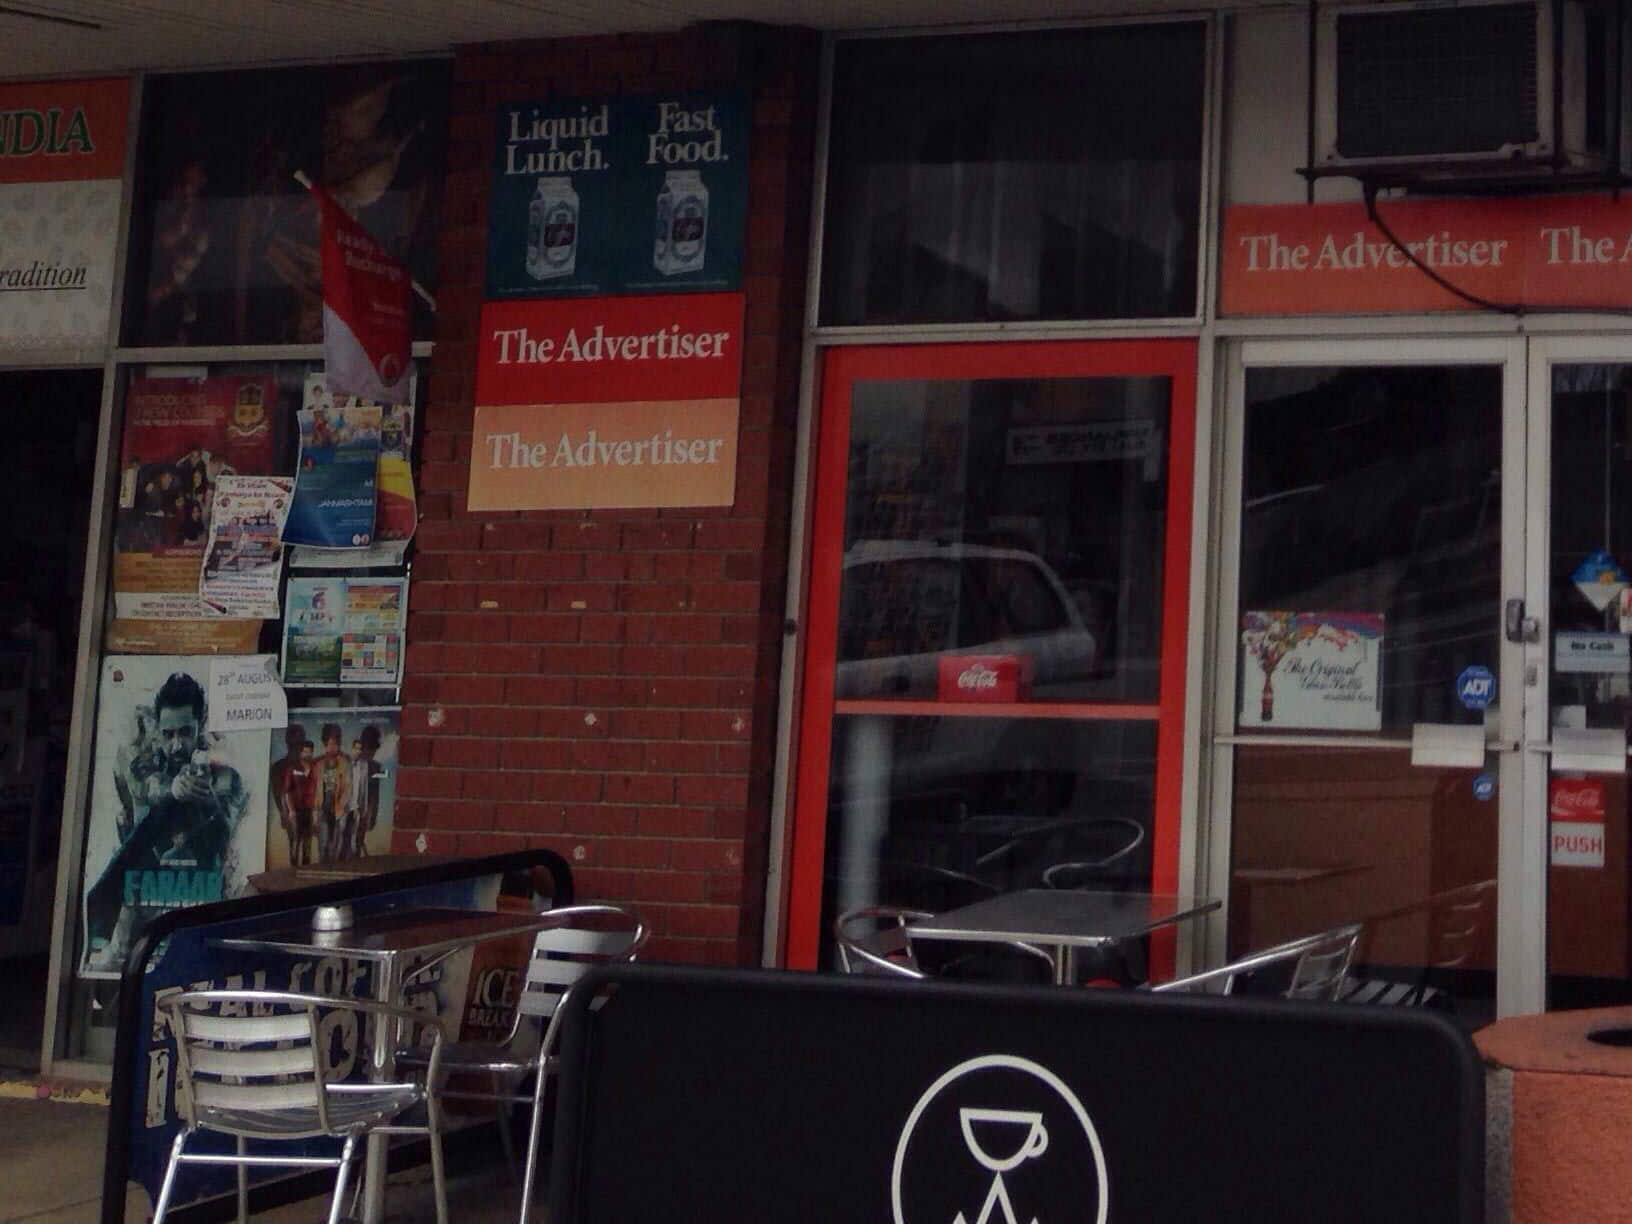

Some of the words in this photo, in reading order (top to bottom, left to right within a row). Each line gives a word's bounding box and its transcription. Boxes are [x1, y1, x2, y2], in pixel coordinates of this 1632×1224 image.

[508, 105, 609, 150] Liquid
[658, 102, 716, 135] Fast
[504, 140, 610, 176] Lunch.
[646, 131, 729, 165] Food.
[1240, 232, 1308, 272] The
[1314, 230, 1508, 271] Advertiser
[1541, 227, 1615, 266] The
[494, 328, 554, 364] The
[556, 324, 729, 363] Advertiser
[486, 432, 546, 470] The
[552, 429, 723, 468] Advertiser
[1463, 679, 1493, 696] ADT
[226, 708, 272, 721] MARION
[1554, 835, 1603, 854] PUSH
[473, 968, 520, 1008] ICE
